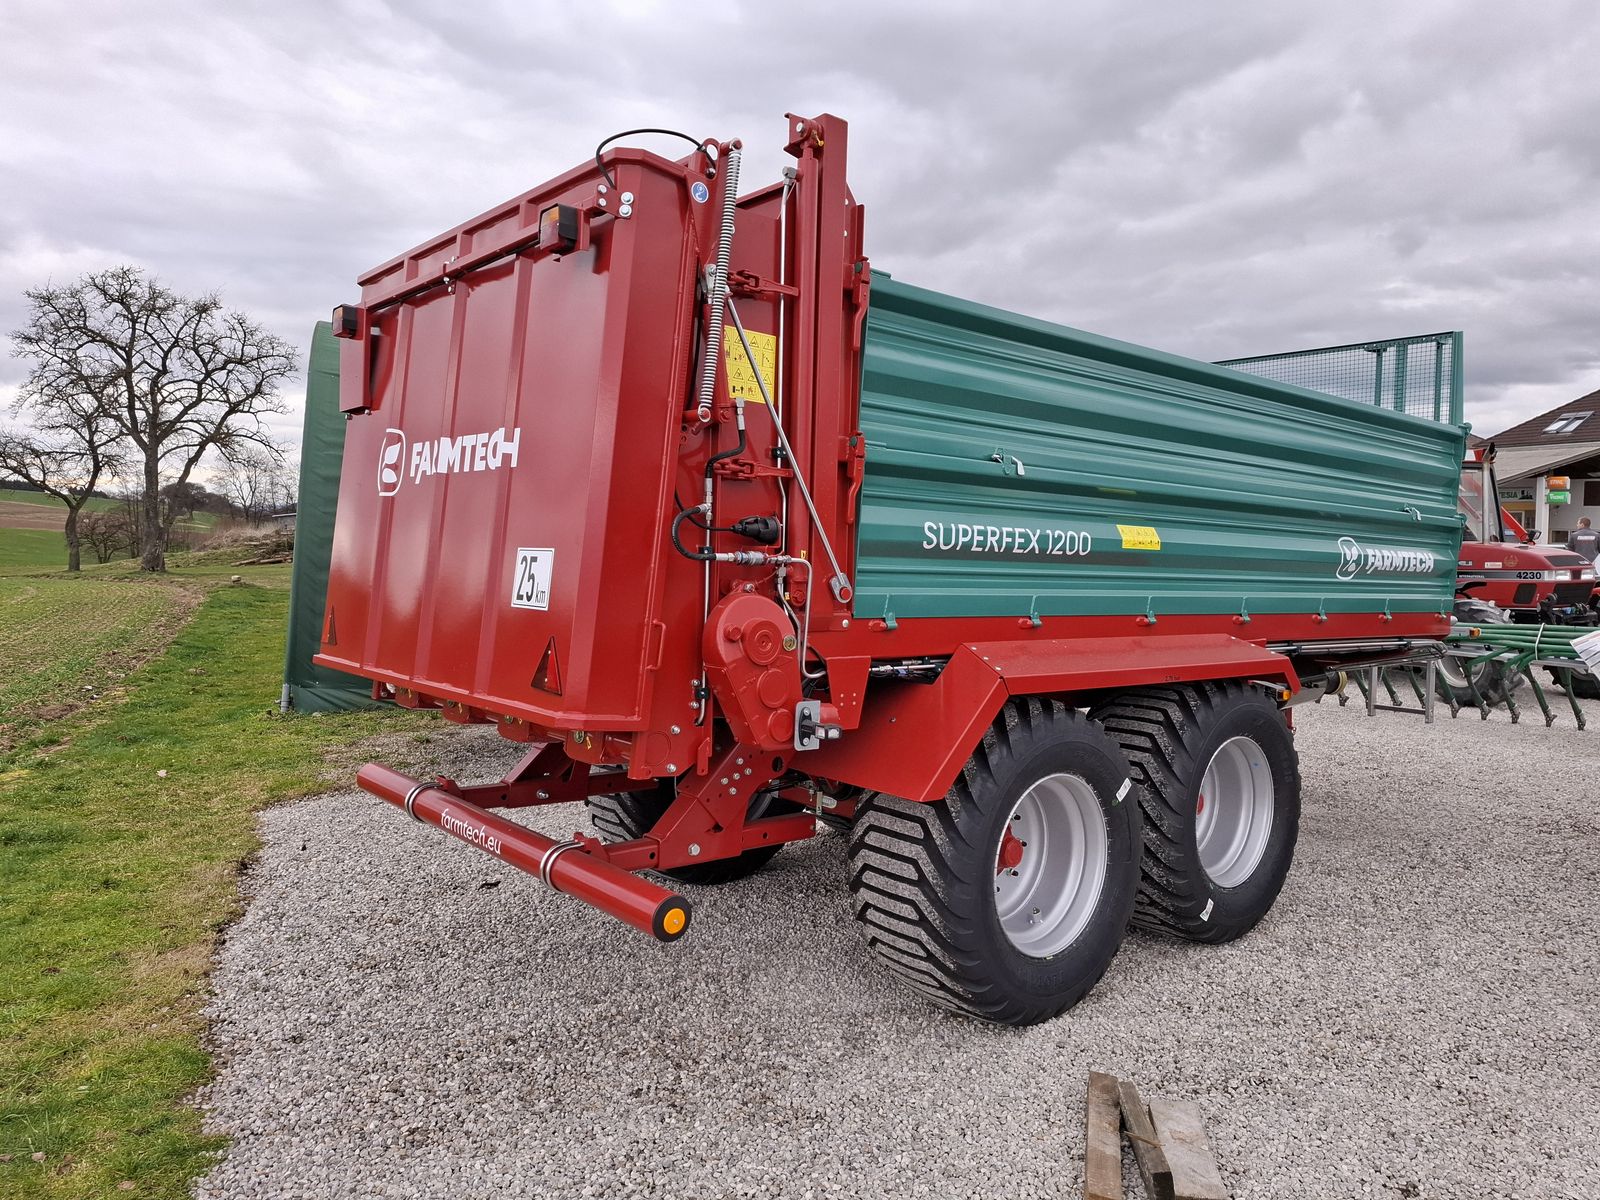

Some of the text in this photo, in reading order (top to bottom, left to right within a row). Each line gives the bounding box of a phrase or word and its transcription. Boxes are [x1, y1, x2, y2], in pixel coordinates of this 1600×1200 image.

[922, 521, 1041, 554] SUPERFEX
[1046, 530, 1092, 556] 1200
[1365, 548, 1435, 575] FARMTECH
[1516, 571, 1542, 580] 4230
[516, 555, 546, 604] 25 km
[441, 808, 502, 855] farmtech.eu
